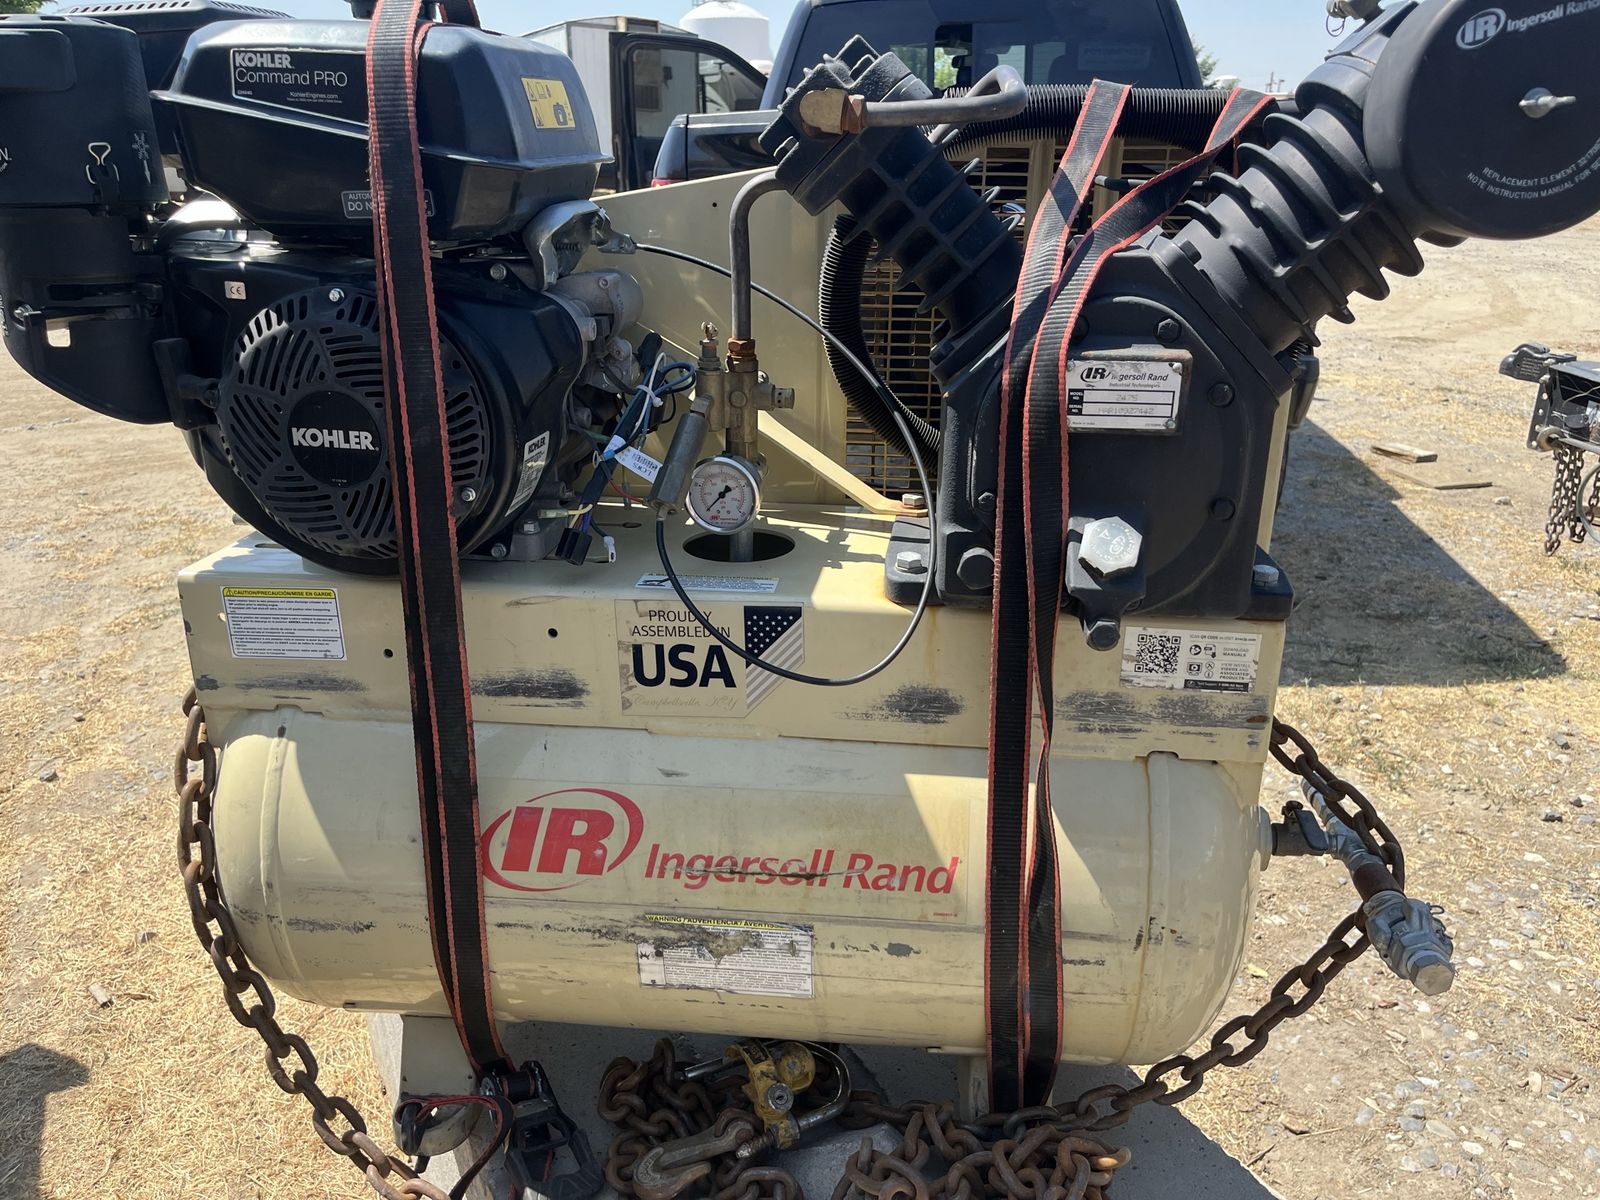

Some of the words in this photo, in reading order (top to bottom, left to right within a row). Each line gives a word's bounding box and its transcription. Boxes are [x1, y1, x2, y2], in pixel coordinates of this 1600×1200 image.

[1506, 4, 1564, 32] Ingersoll
[235, 52, 293, 69] KOHLER
[235, 68, 310, 85] Command
[314, 71, 348, 87] PRO
[1467, 172, 1488, 189] NOTE
[1487, 185, 1539, 199] INSTRUCTION
[1540, 181, 1574, 197] MANUAL
[1574, 168, 1592, 183] FOR
[1482, 167, 1538, 187] REPLACEMENT
[1540, 164, 1577, 185] ELEMENT
[348, 201, 363, 211] DO
[1147, 373, 1169, 381] Rand
[291, 427, 376, 451] KOHLER
[527, 436, 547, 455] KOHLER
[649, 610, 712, 622] PROUDY
[632, 625, 712, 638] ASSEMBLED
[632, 644, 737, 688] USA
[501, 806, 616, 876] IR
[644, 843, 836, 891] Ingersoll
[841, 852, 961, 895] Rand
[647, 914, 682, 922] WARNING
